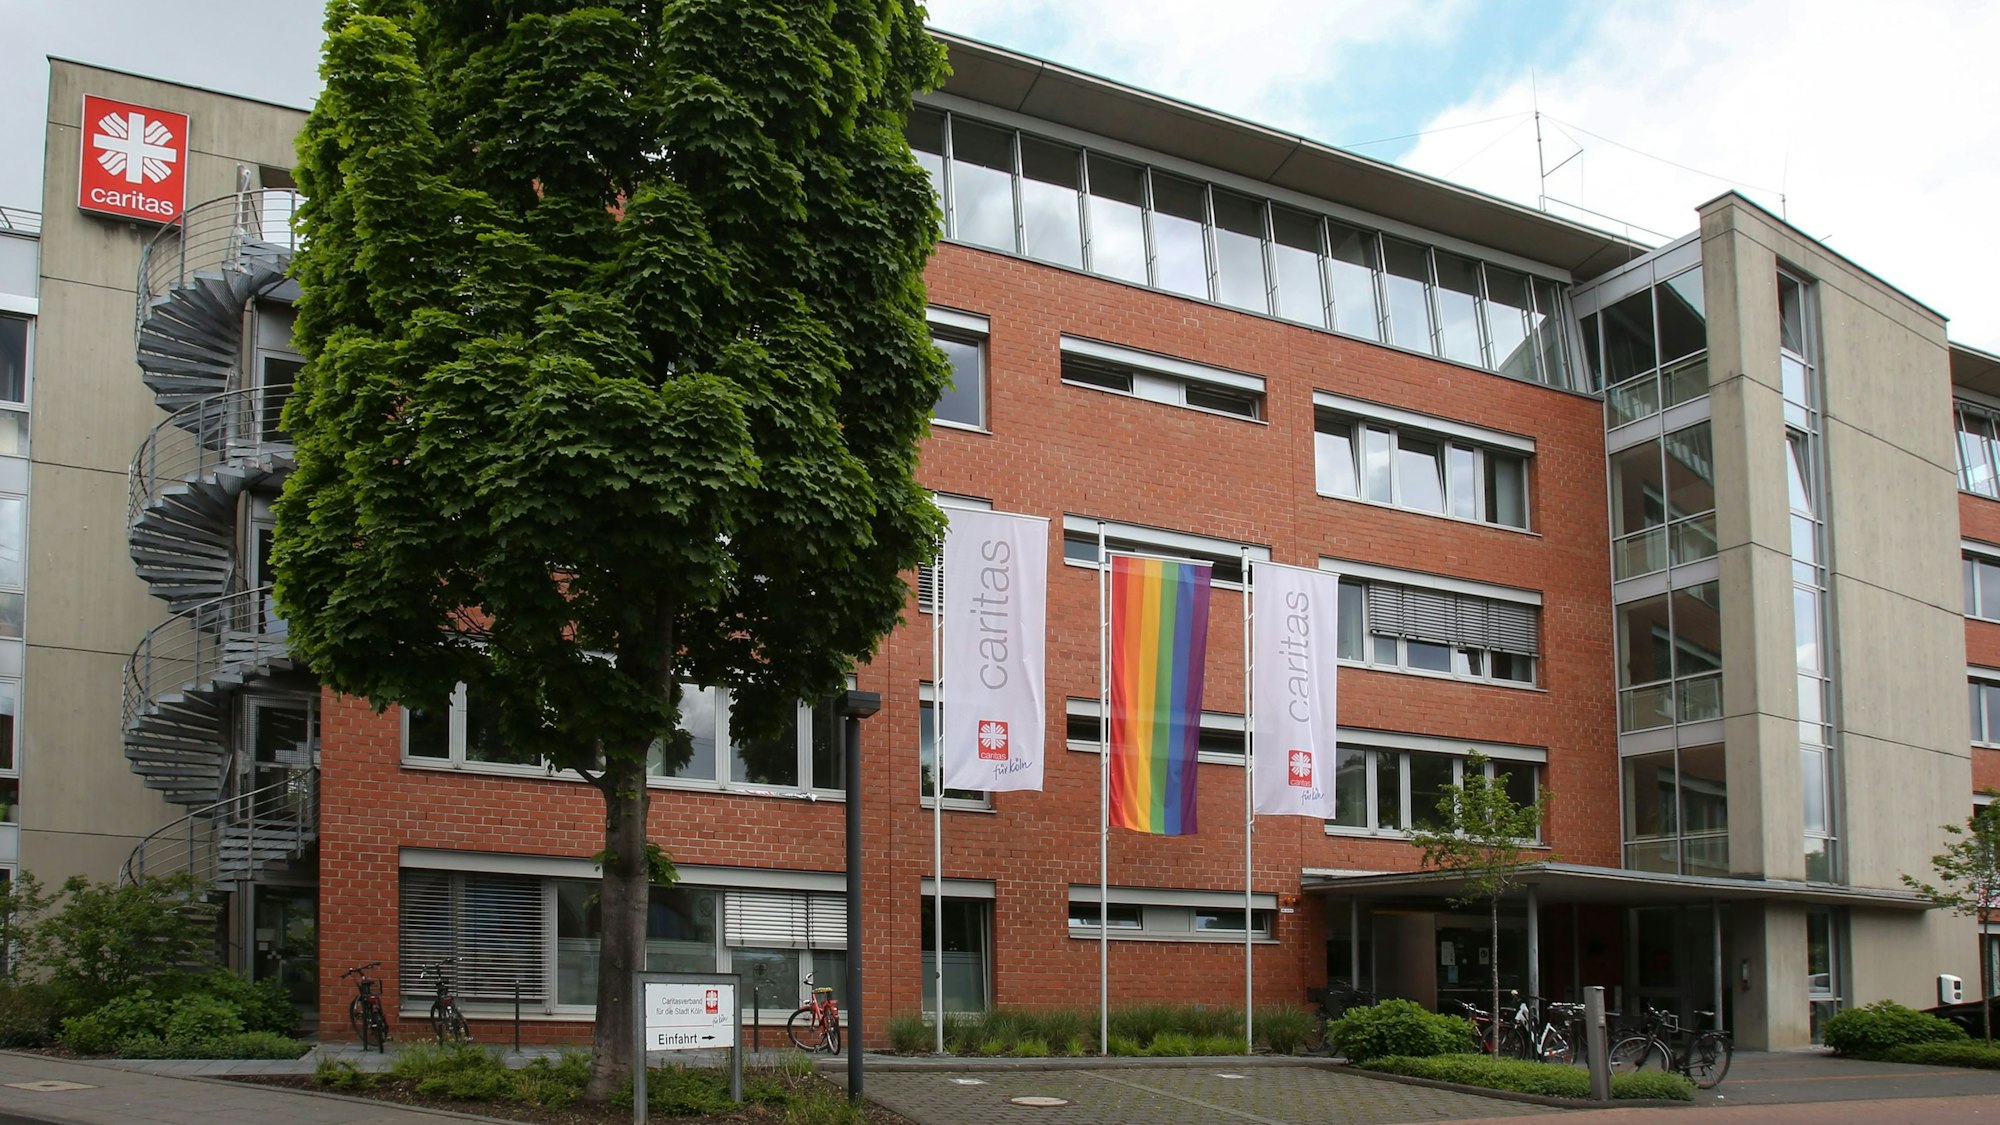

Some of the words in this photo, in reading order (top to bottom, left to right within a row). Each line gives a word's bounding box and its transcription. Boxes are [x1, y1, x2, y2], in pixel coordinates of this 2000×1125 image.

[91, 188, 174, 215] caritas
[970, 539, 1011, 691] caritas
[1278, 590, 1310, 724] caritas
[980, 752, 1007, 760] caritas
[992, 763, 1008, 781] für
[662, 997, 703, 1005] Caritasverband
[656, 1007, 664, 1015] für
[665, 1007, 673, 1015] die
[675, 1007, 689, 1015] Stadt
[690, 1007, 703, 1015] Köln
[658, 1033, 698, 1044] Einfahrt
